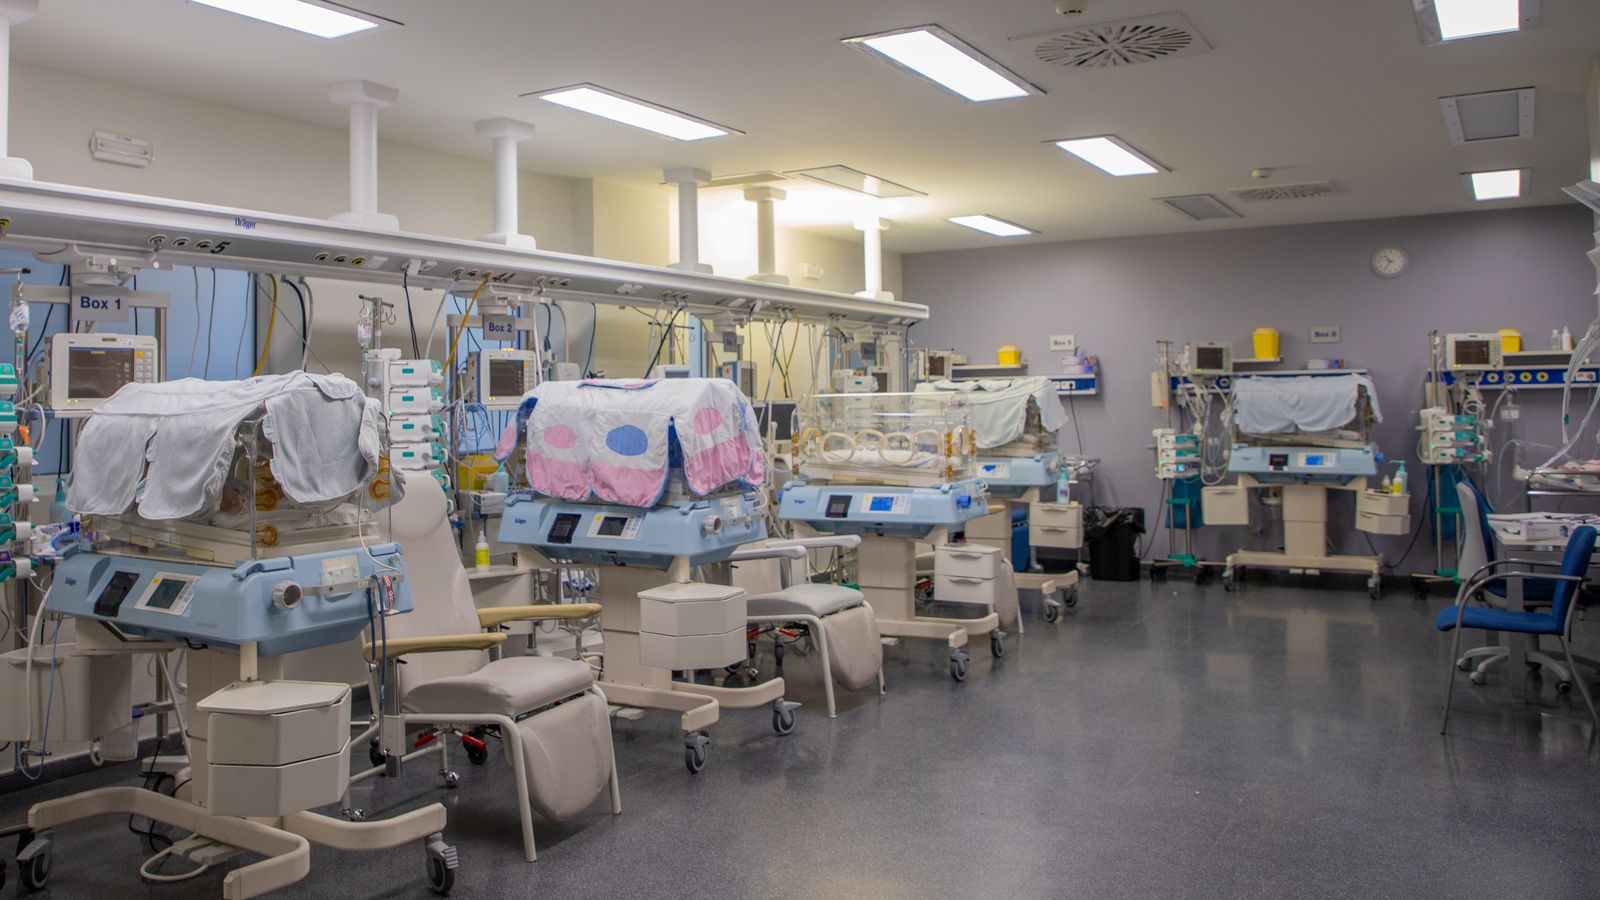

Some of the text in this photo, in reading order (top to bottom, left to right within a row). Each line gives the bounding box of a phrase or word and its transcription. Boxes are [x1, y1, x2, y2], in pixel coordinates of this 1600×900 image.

[210, 241, 231, 254] 5
[80, 296, 121, 310] Box 1
[489, 322, 513, 333] Box 2
